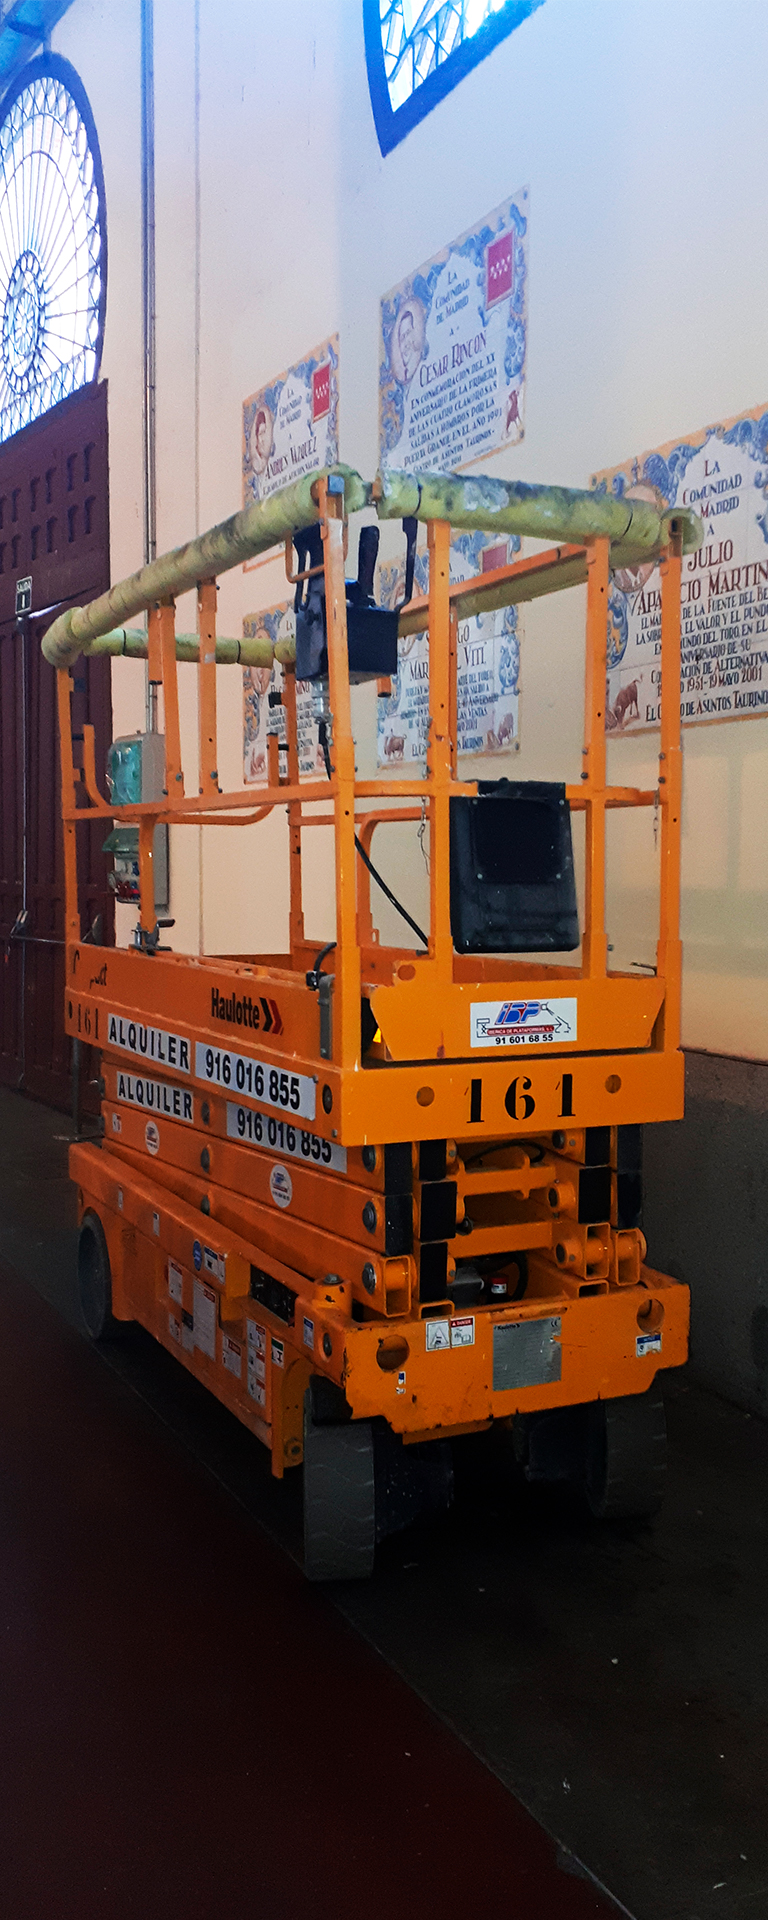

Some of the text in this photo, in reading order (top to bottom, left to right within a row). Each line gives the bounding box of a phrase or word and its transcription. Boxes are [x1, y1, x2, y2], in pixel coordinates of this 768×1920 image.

[435, 279, 470, 309] COMUNIDAD
[436, 295, 469, 324] DE MADRID
[420, 355, 449, 387] CESAR
[471, 360, 484, 374] DEL
[409, 380, 498, 439] DE LAS CUATRO CLAMOROSAS
[410, 367, 498, 424] ANIVERSARIO DE LA PRIMERA
[411, 431, 435, 449] SALIDAS
[441, 411, 470, 434] HOMBROS
[471, 402, 485, 417] POR
[486, 397, 495, 409] LA
[404, 448, 426, 468] PUERTA
[452, 429, 461, 441] EN
[462, 424, 469, 436] EL
[472, 416, 486, 430] AÑO
[704, 460, 721, 478] LA
[683, 473, 743, 506] COMUNIDAD
[701, 495, 740, 518] MADRID
[707, 523, 715, 537] A
[687, 539, 734, 572] JULIO
[641, 617, 650, 630] EL
[682, 606, 692, 620] DE
[694, 603, 705, 617] LA
[707, 595, 737, 614] FUENTE
[739, 591, 755, 606] DEL
[636, 633, 646, 646] LA
[685, 621, 696, 634] EL
[696, 614, 721, 630] VALOR
[722, 612, 728, 625] Y
[730, 610, 742, 624] EL
[703, 633, 718, 647] DEL
[741, 624, 753, 637] EN
[756, 619, 768, 634] EL
[727, 641, 738, 655] DE
[741, 637, 751, 652] SU
[703, 661, 713, 675] DE
[741, 667, 762, 683] 2001
[685, 702, 696, 716] DE
[698, 696, 732, 714] ASUNTOS
[77, 1003, 99, 1040] 161
[211, 986, 261, 1030] Haulotte
[495, 1033, 554, 1045] 91 601 68 55
[109, 1017, 300, 1110] ALQUILER 916 016 855
[464, 1073, 576, 1123] 161
[118, 1074, 332, 1164] ALQUILER 916 016 855
